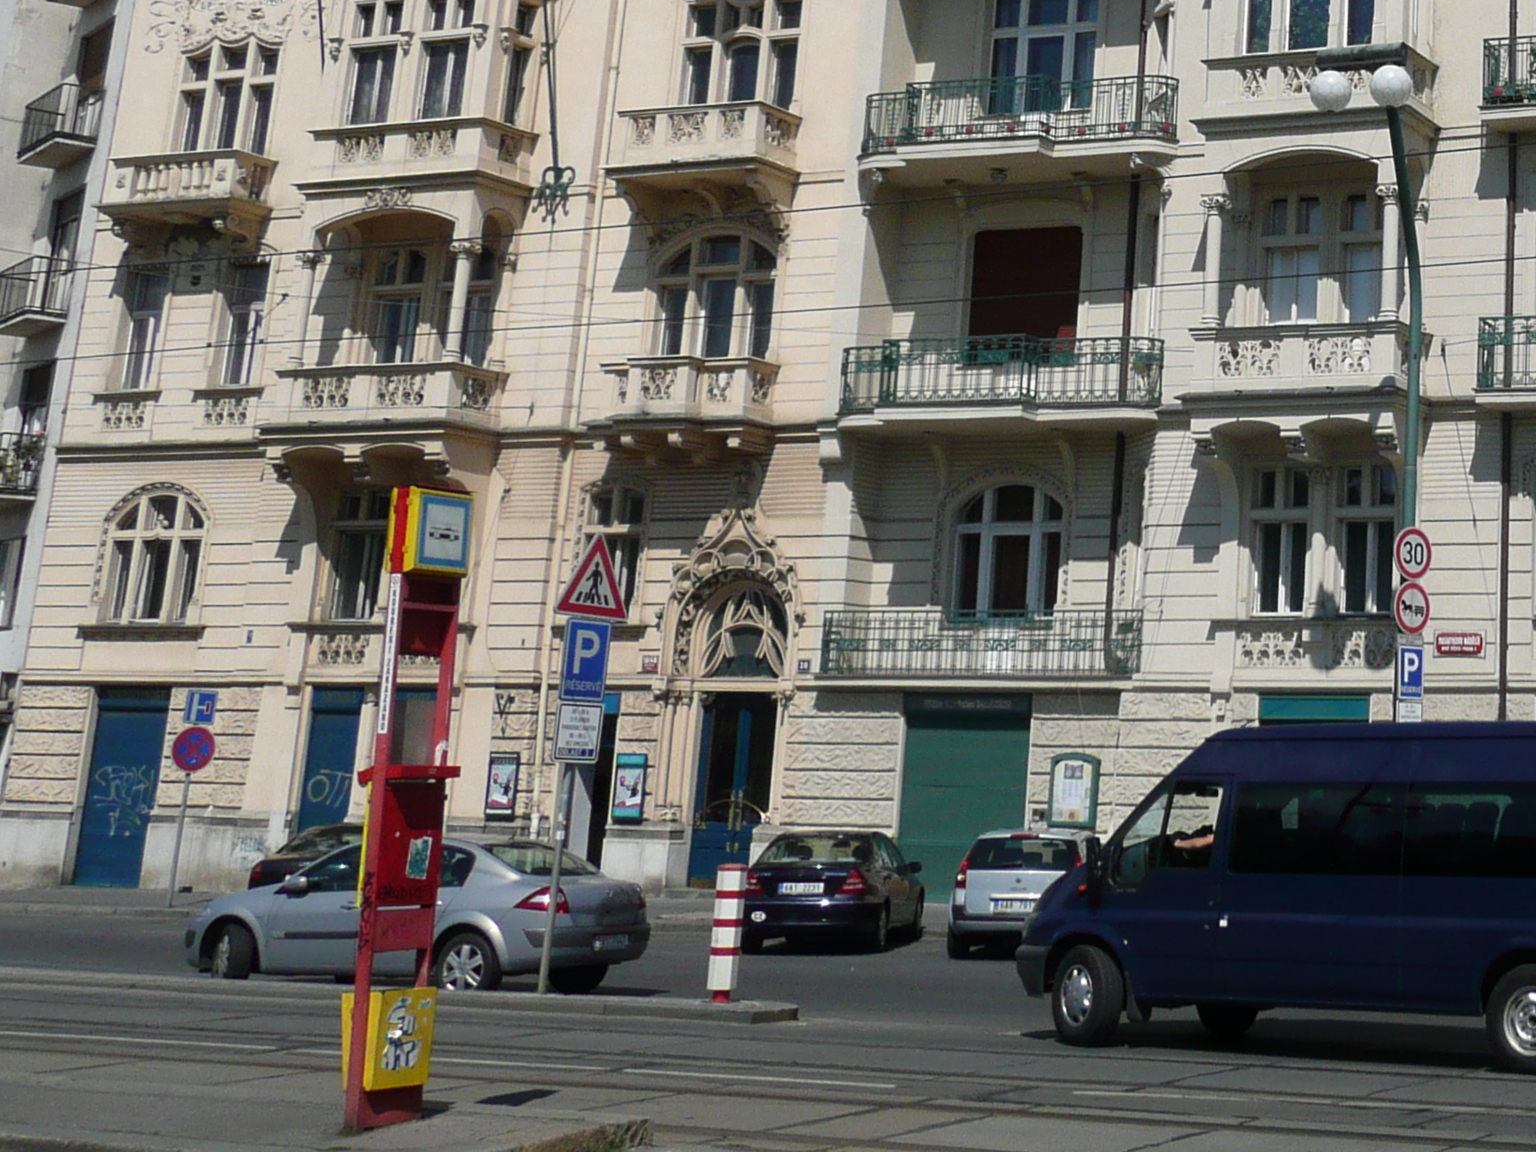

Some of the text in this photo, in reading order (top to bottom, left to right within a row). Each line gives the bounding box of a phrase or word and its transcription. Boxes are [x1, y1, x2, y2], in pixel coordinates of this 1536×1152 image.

[1403, 541, 1424, 566] 30
[572, 629, 601, 675] P
[1404, 652, 1420, 682] P
